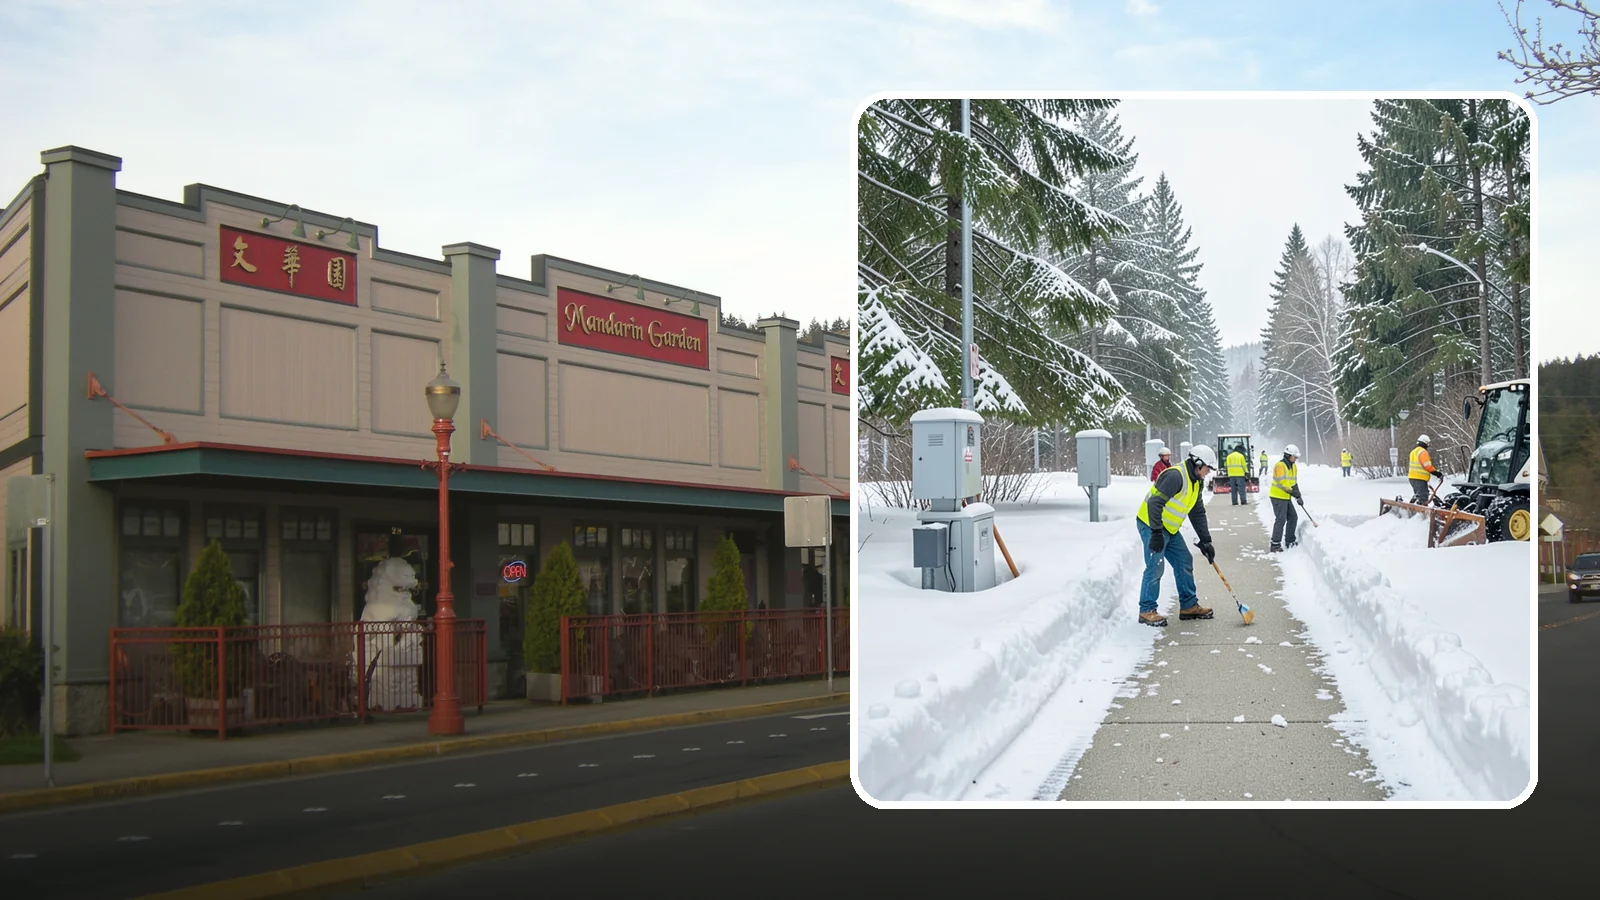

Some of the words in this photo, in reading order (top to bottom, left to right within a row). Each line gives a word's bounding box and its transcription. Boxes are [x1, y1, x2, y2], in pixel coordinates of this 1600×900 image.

[230, 236, 346, 290] 文華園
[564, 302, 644, 341] Mandarin
[648, 320, 701, 352] Garden
[503, 565, 527, 578] OPEN
